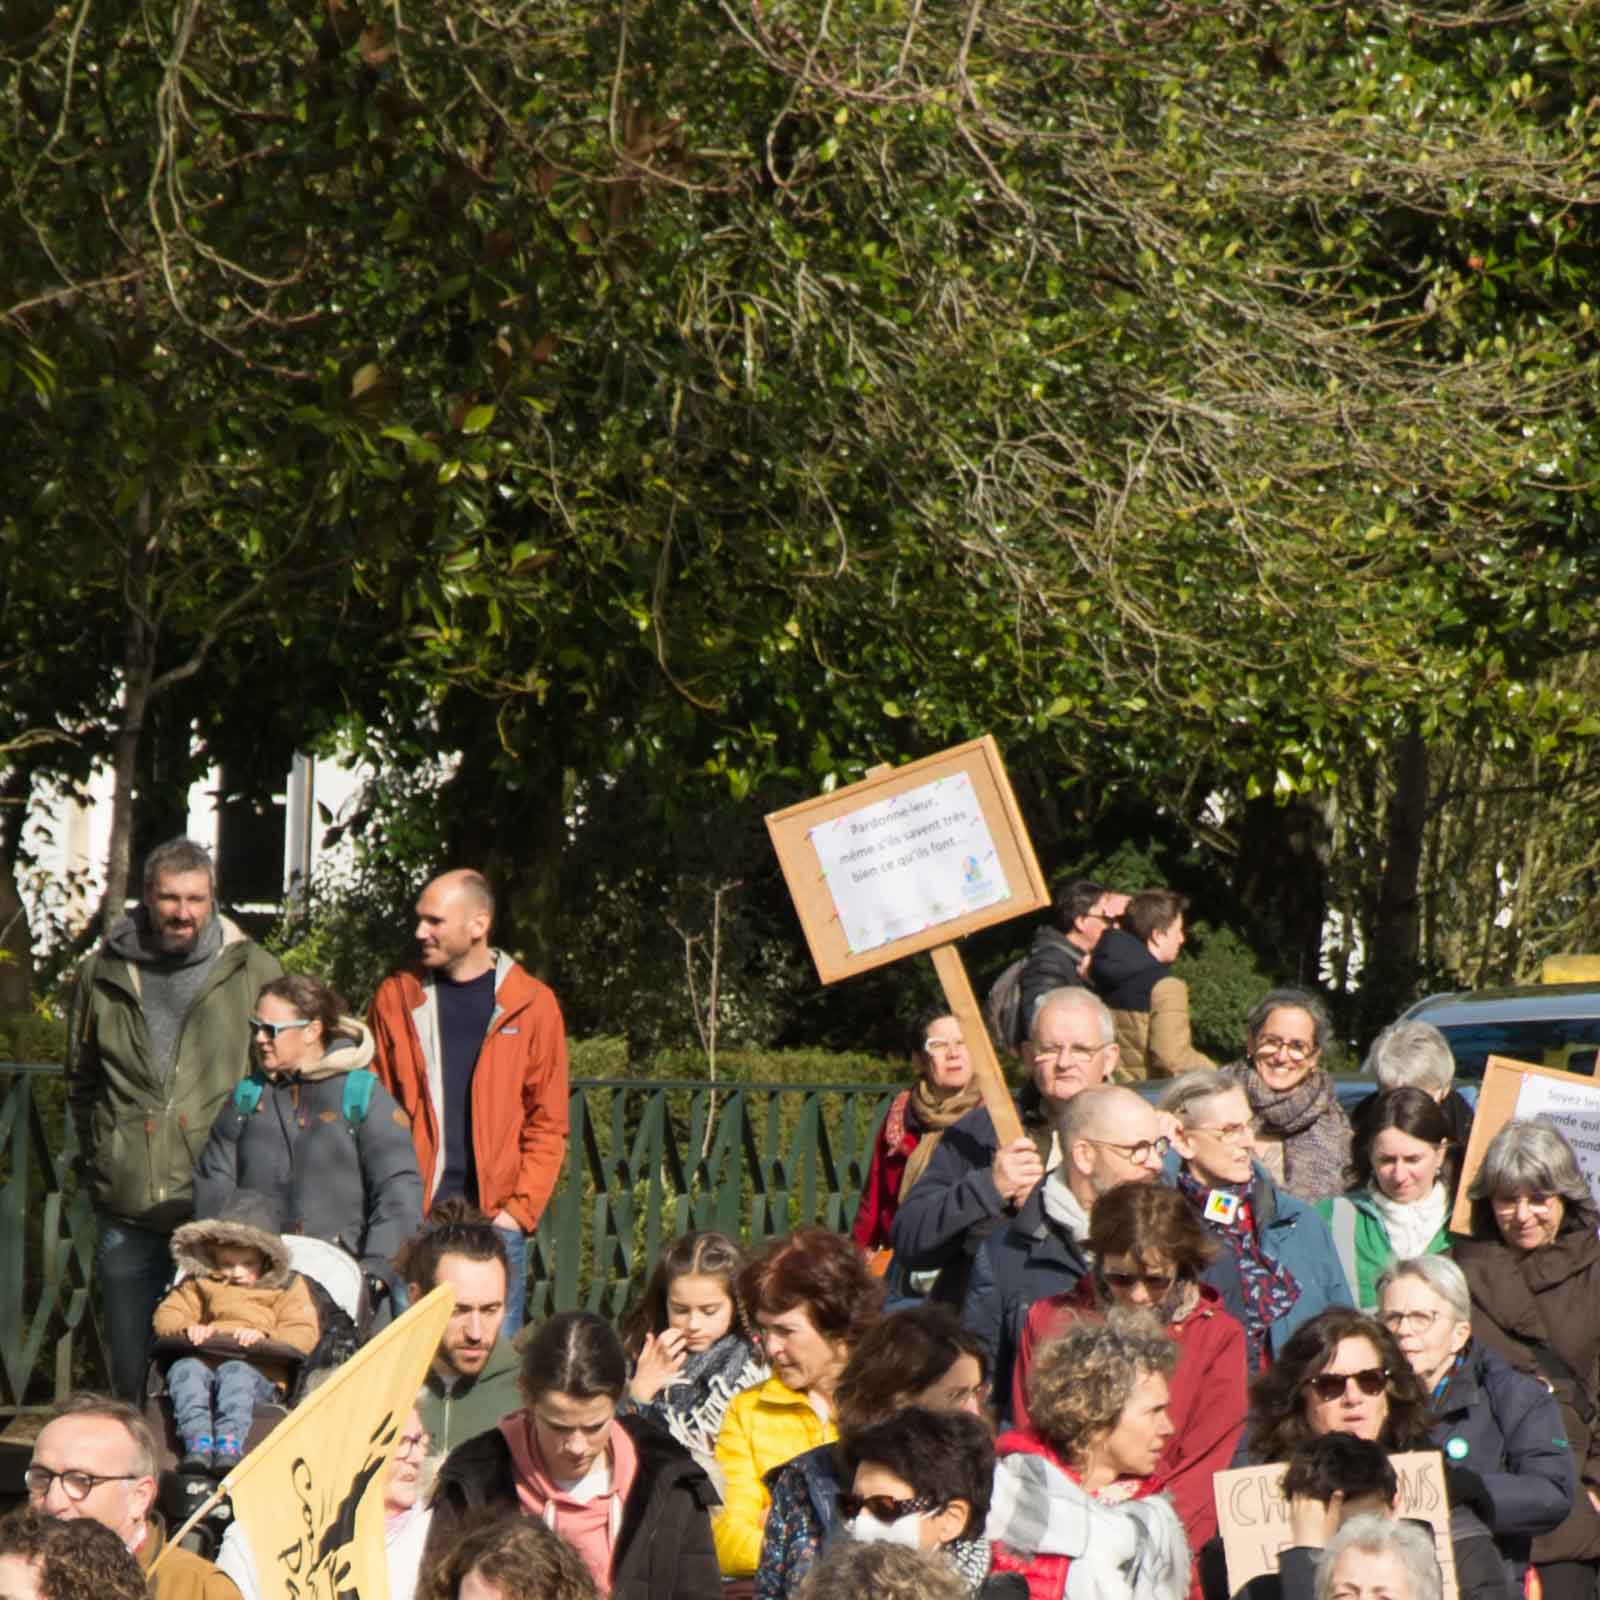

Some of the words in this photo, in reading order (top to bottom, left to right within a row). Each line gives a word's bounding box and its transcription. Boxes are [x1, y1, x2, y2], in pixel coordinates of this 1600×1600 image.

[838, 843, 874, 864] même
[904, 819, 941, 842] savent
[943, 810, 967, 827] très
[851, 864, 878, 884] bien
[880, 857, 895, 871] ce
[1580, 1120, 1600, 1132] qui
